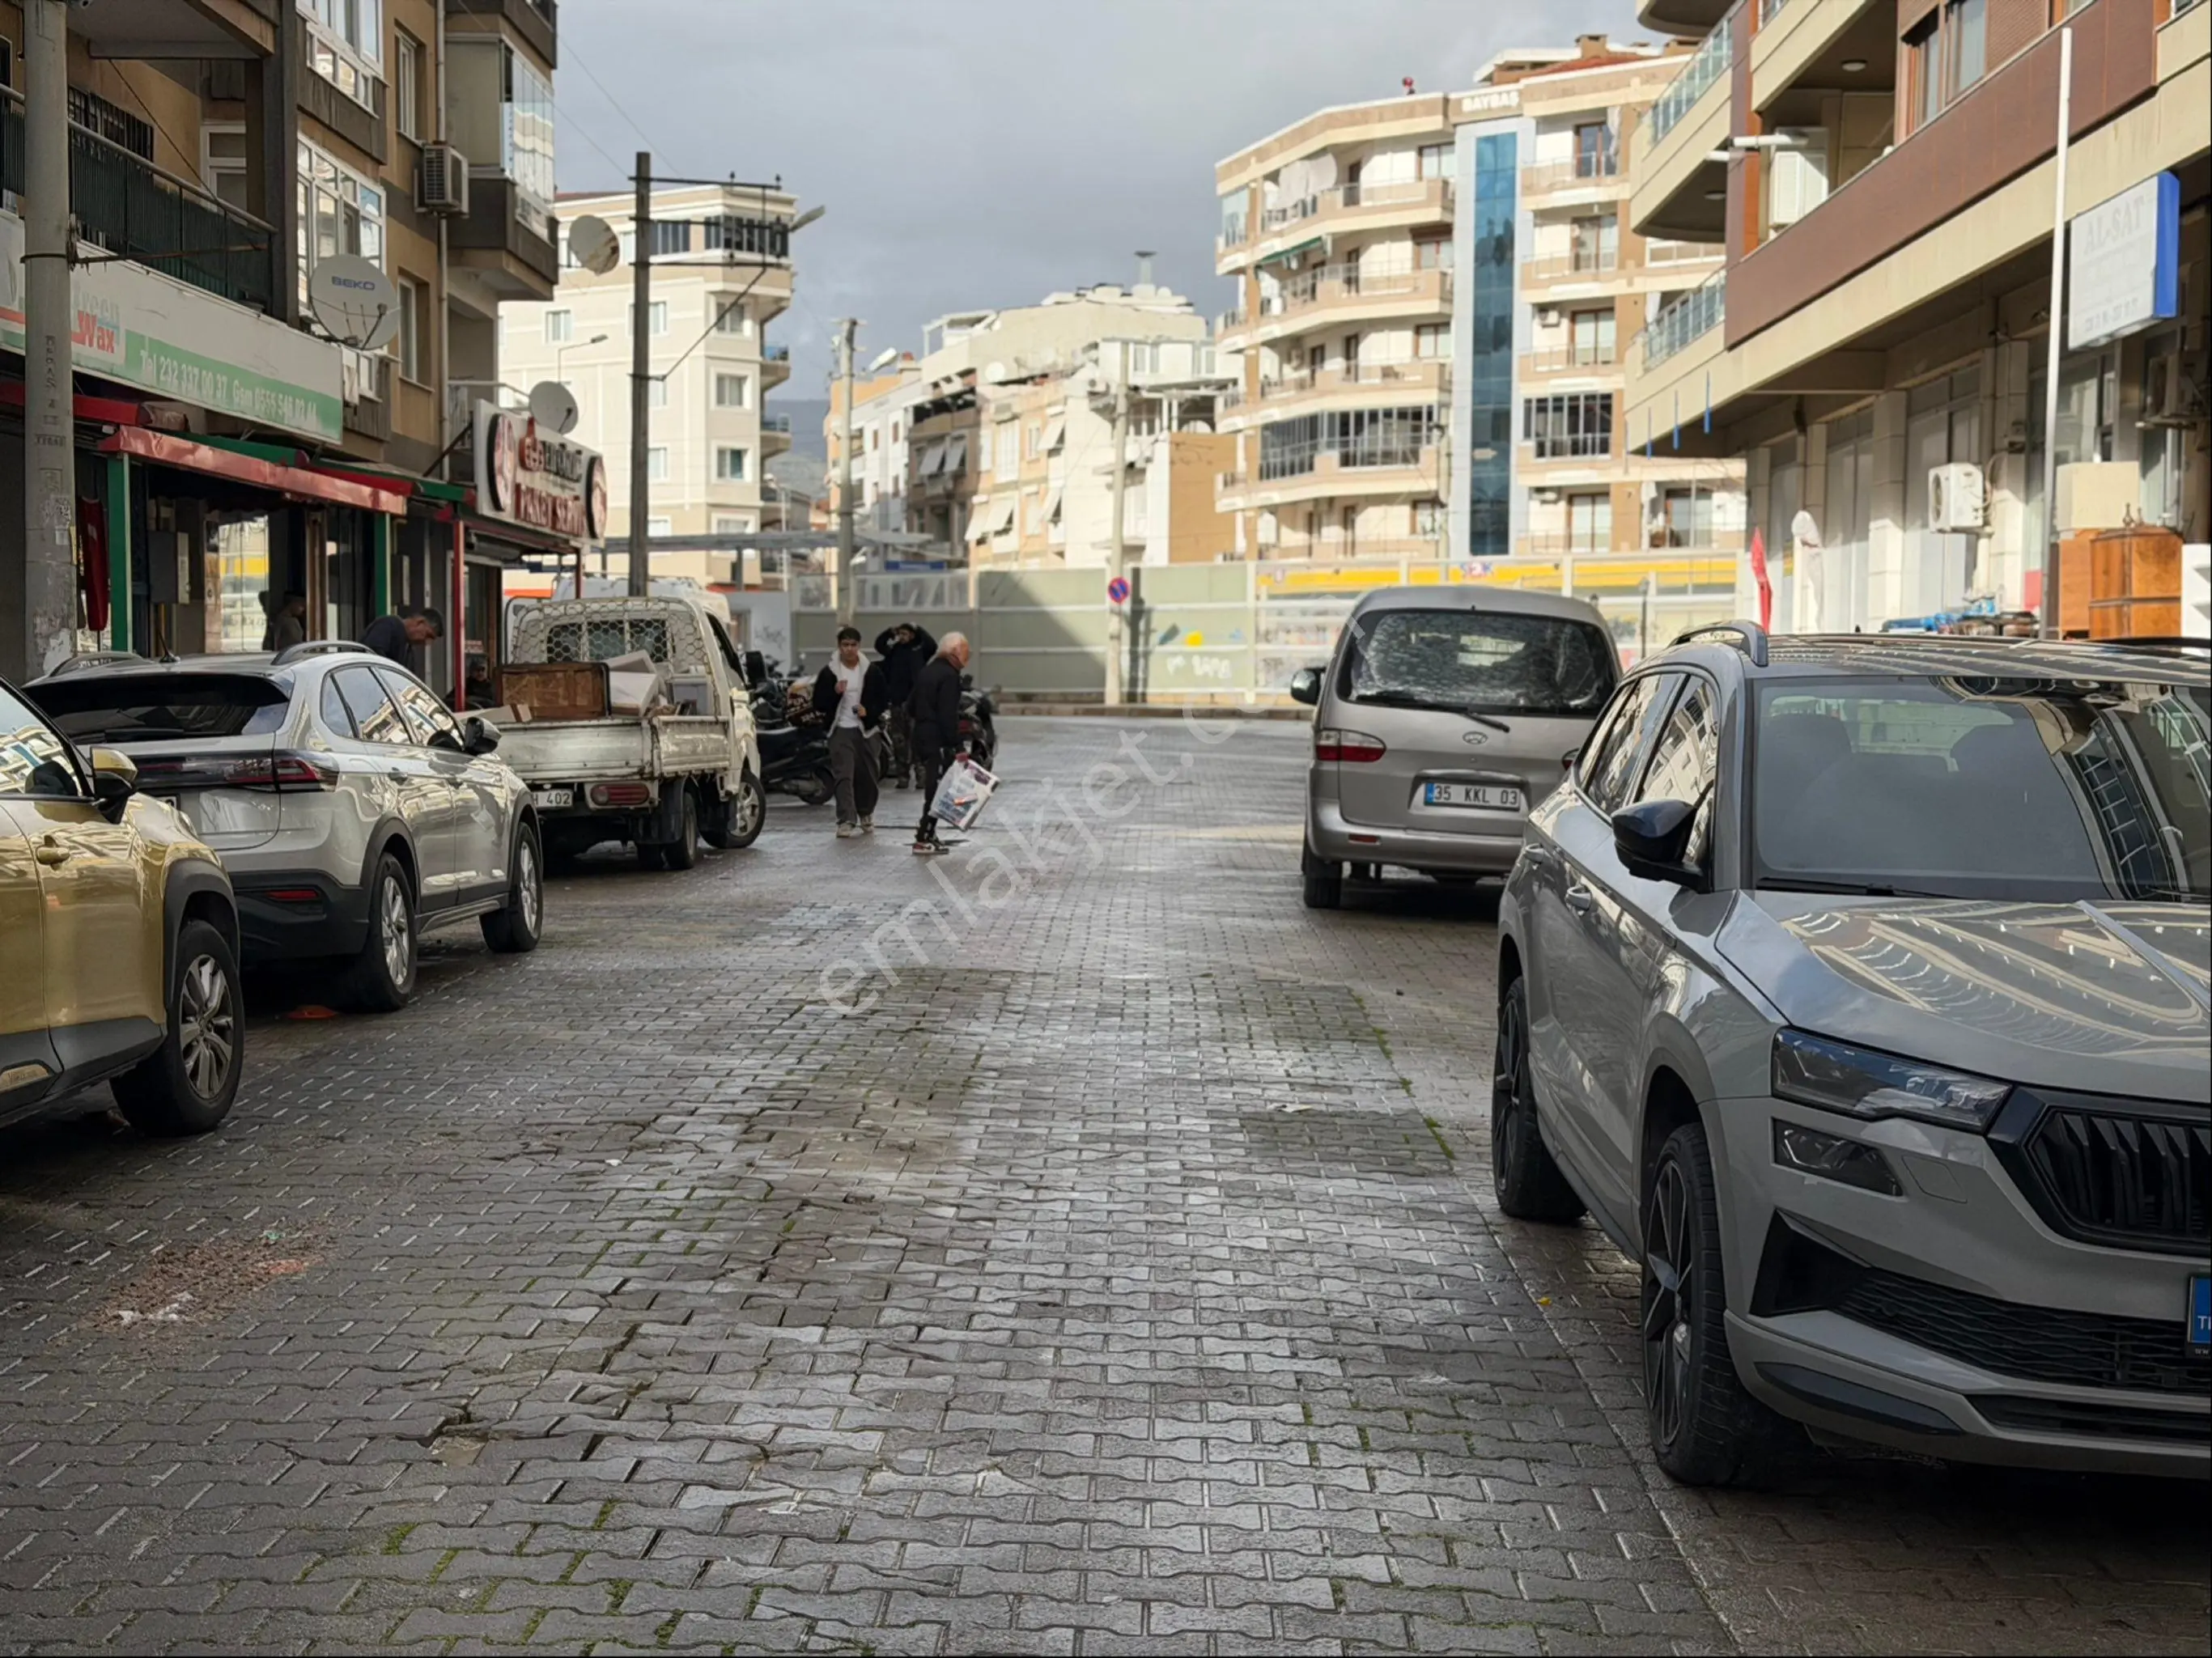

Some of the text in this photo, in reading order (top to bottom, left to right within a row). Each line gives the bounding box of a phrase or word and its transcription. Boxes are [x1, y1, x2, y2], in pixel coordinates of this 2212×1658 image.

[332, 276, 376, 290] BEKO
[77, 310, 115, 354] Wax
[159, 355, 179, 385] 232
[181, 363, 200, 395] 337
[216, 374, 227, 402] 37
[233, 380, 253, 409] Gsm
[546, 793, 571, 805] 402
[1435, 786, 1518, 805] 35 KKL 03
[2197, 1315, 2211, 1330] T
